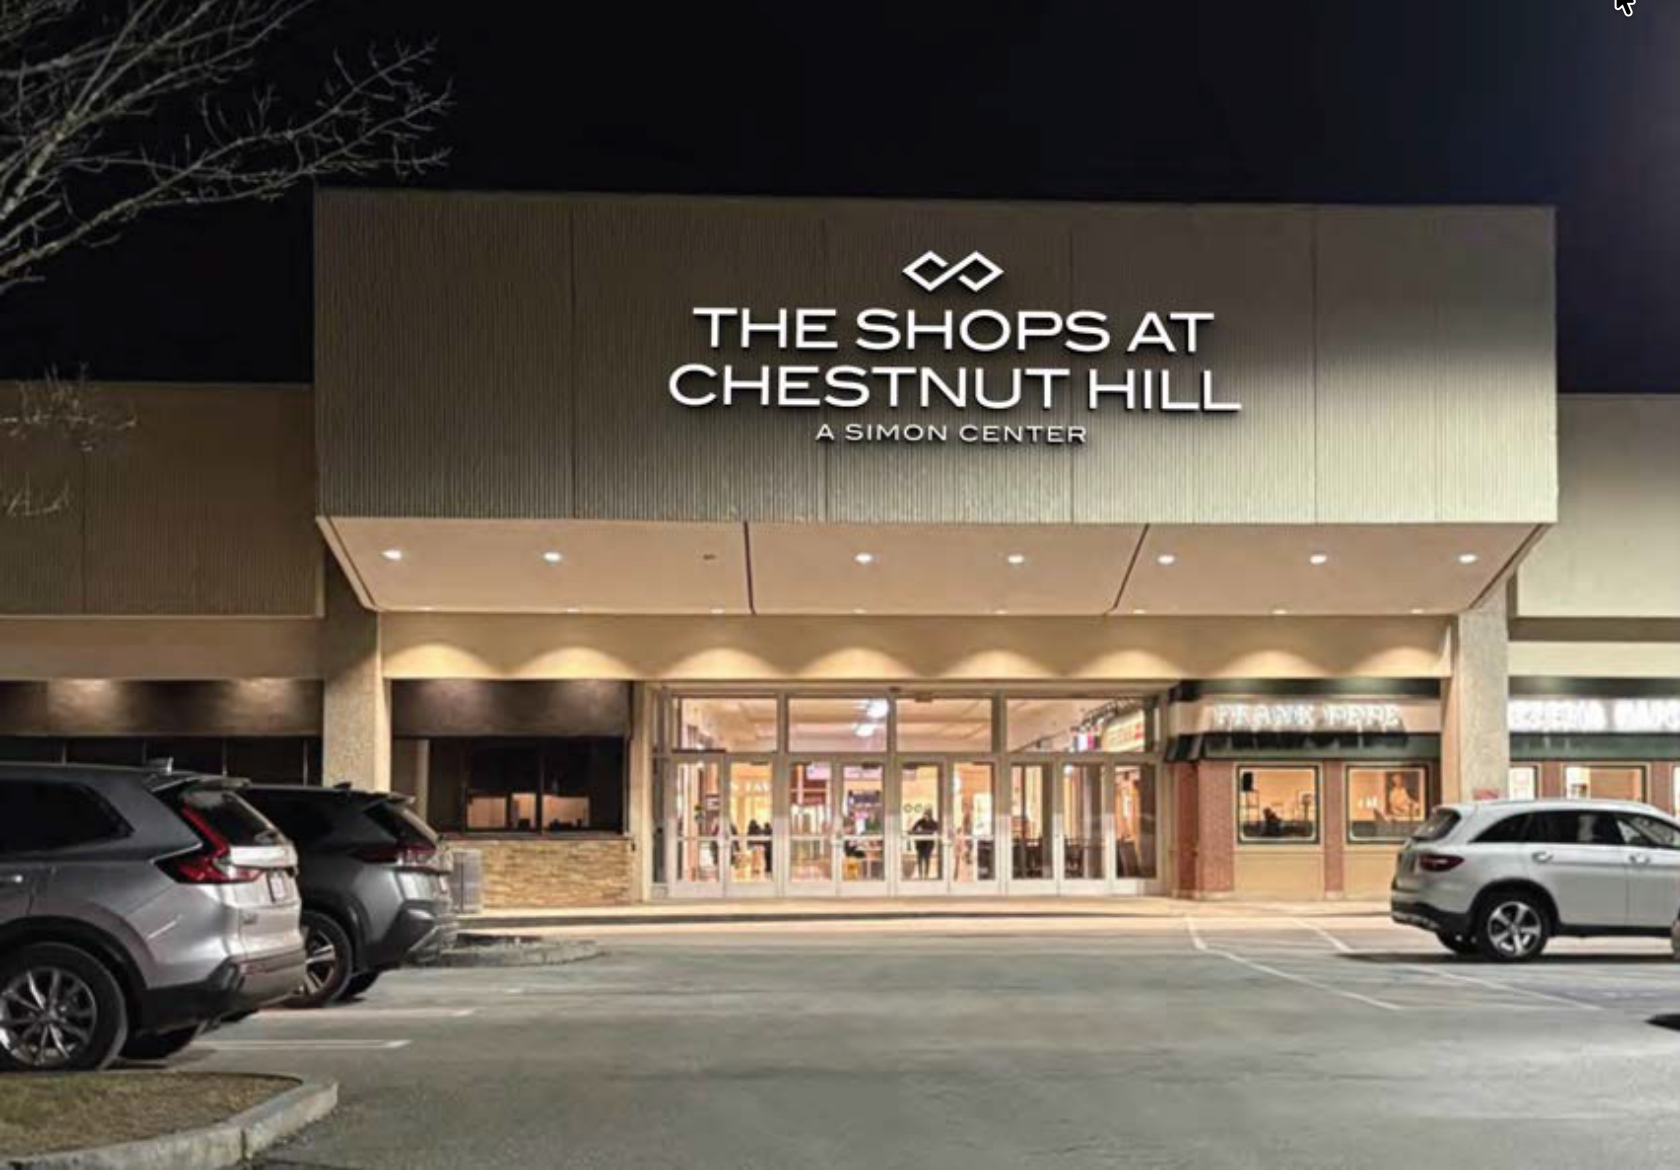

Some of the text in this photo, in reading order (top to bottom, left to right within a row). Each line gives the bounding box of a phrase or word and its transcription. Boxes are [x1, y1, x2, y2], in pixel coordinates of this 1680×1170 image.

[693, 307, 1215, 352] THE SHOPS AT
[669, 363, 1243, 411] CHESTNUT HILL
[815, 423, 1087, 443] A SIMON CENTER
[1212, 702, 1400, 727] FRANK PEPE
